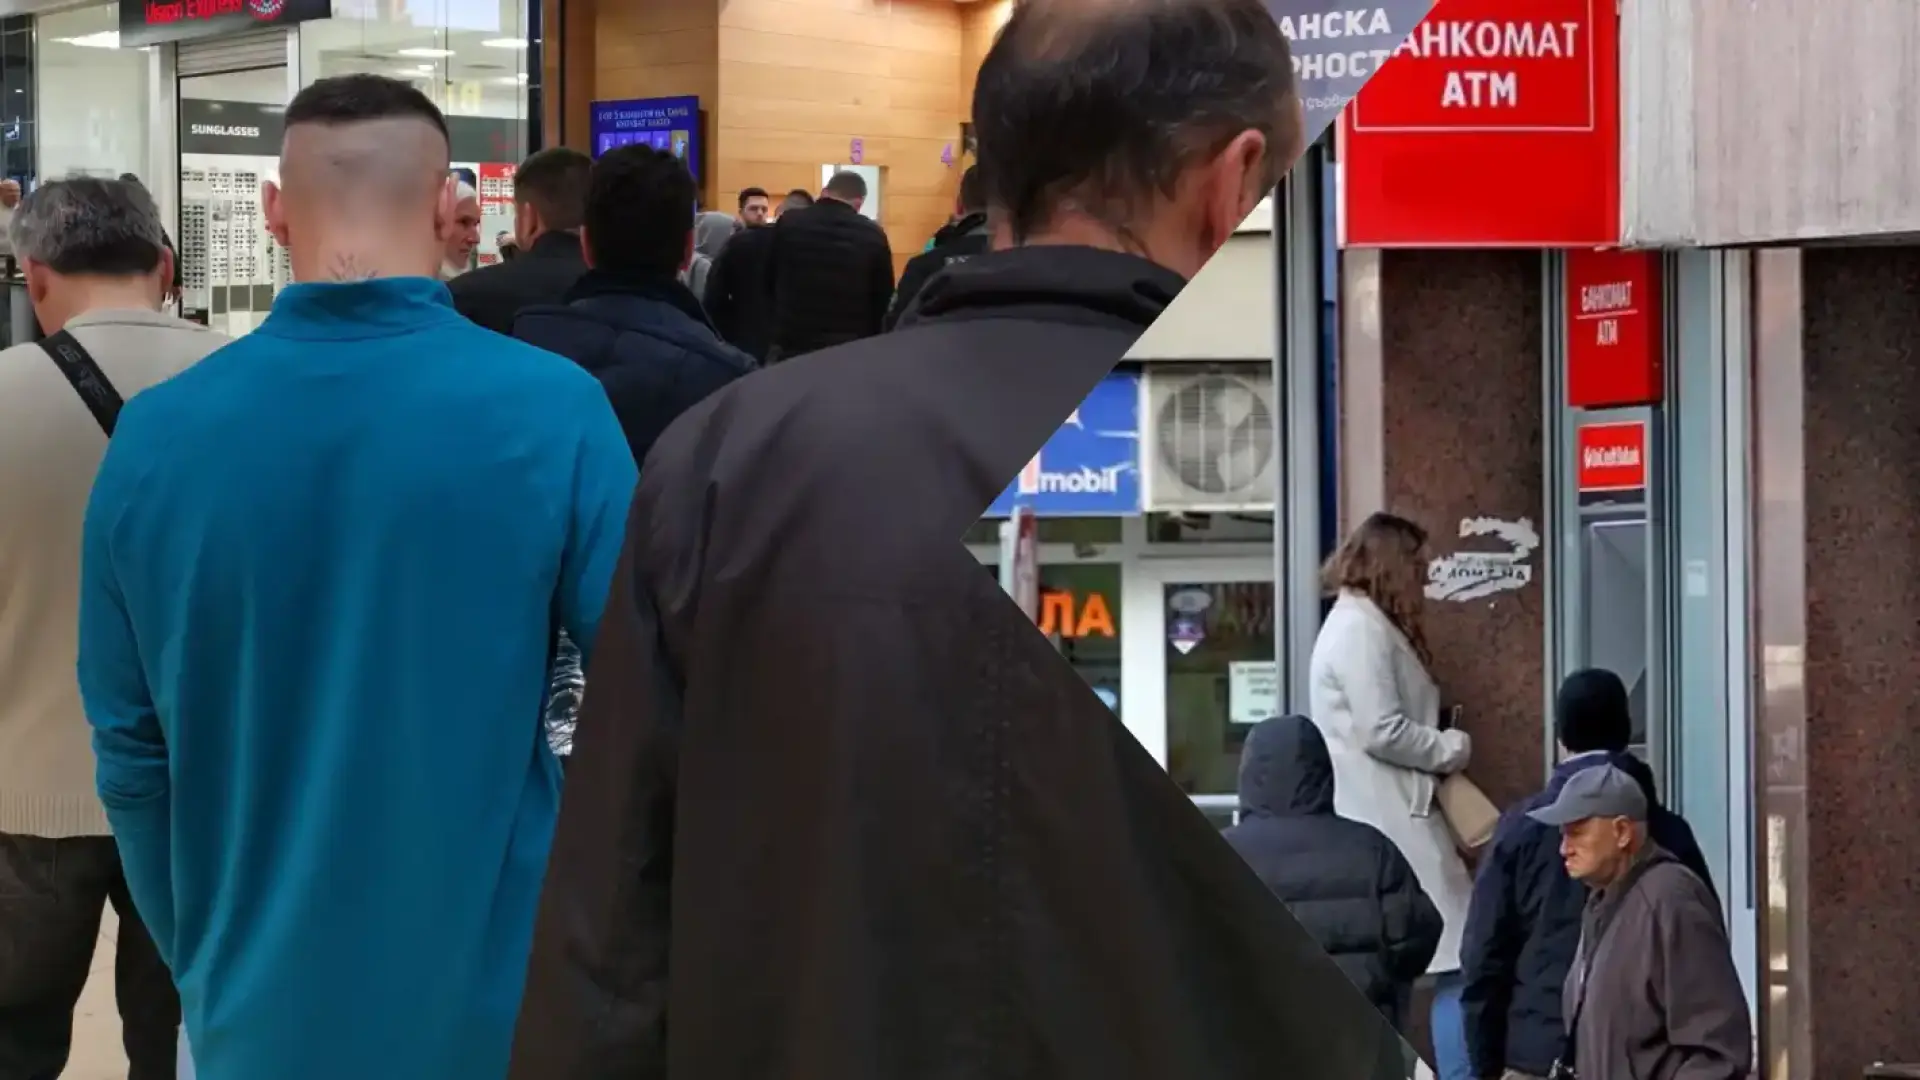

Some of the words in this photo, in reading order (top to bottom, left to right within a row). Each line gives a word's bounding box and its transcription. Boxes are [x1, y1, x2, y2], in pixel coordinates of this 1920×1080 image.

[1280, 7, 1392, 40] АНСКА
[191, 123, 260, 137] SUNGLASSES
[1038, 591, 1117, 638] ЛА
